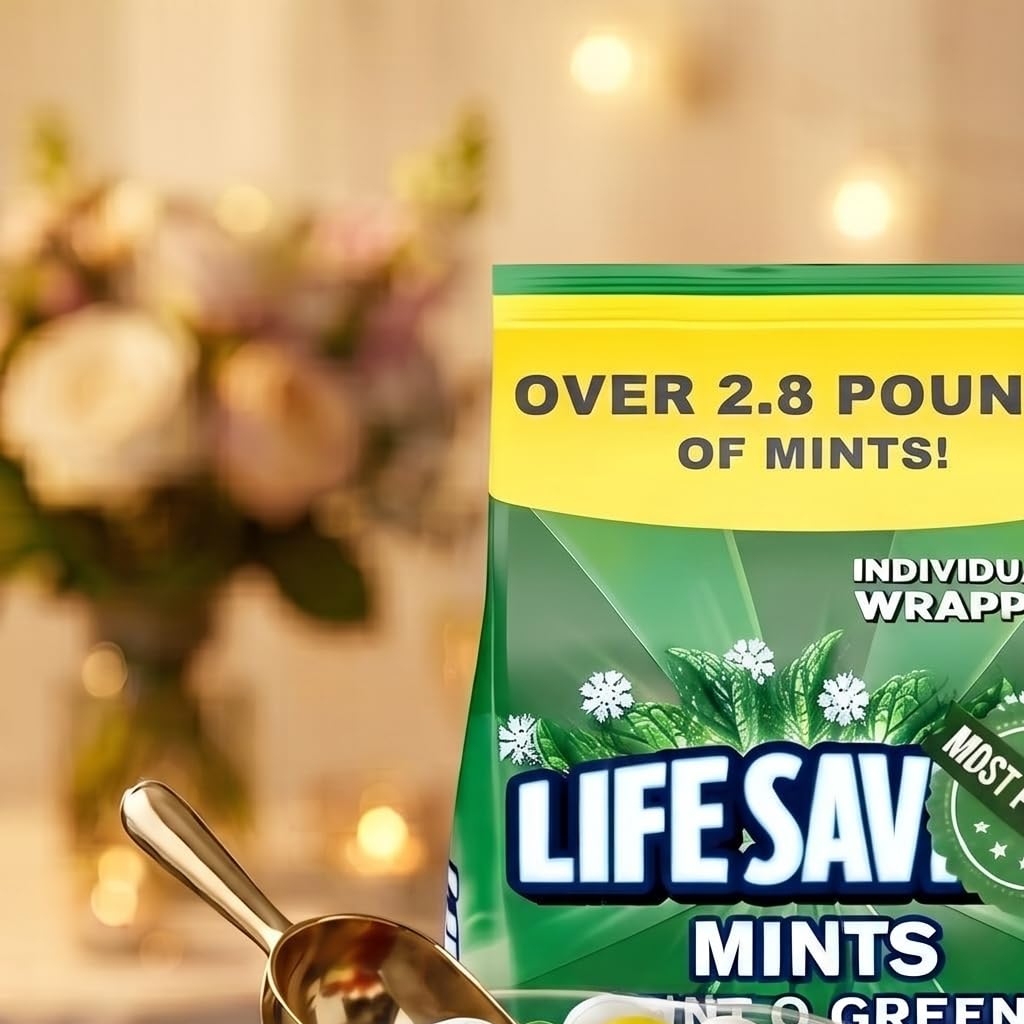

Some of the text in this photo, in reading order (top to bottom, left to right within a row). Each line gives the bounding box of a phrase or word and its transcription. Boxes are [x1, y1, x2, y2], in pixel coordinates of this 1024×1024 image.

[515, 375, 694, 415] OVER
[717, 374, 813, 416] 2.8
[678, 437, 949, 470] OF MINTS!
[942, 725, 1022, 796] MOST
[694, 920, 938, 977] MINTS
